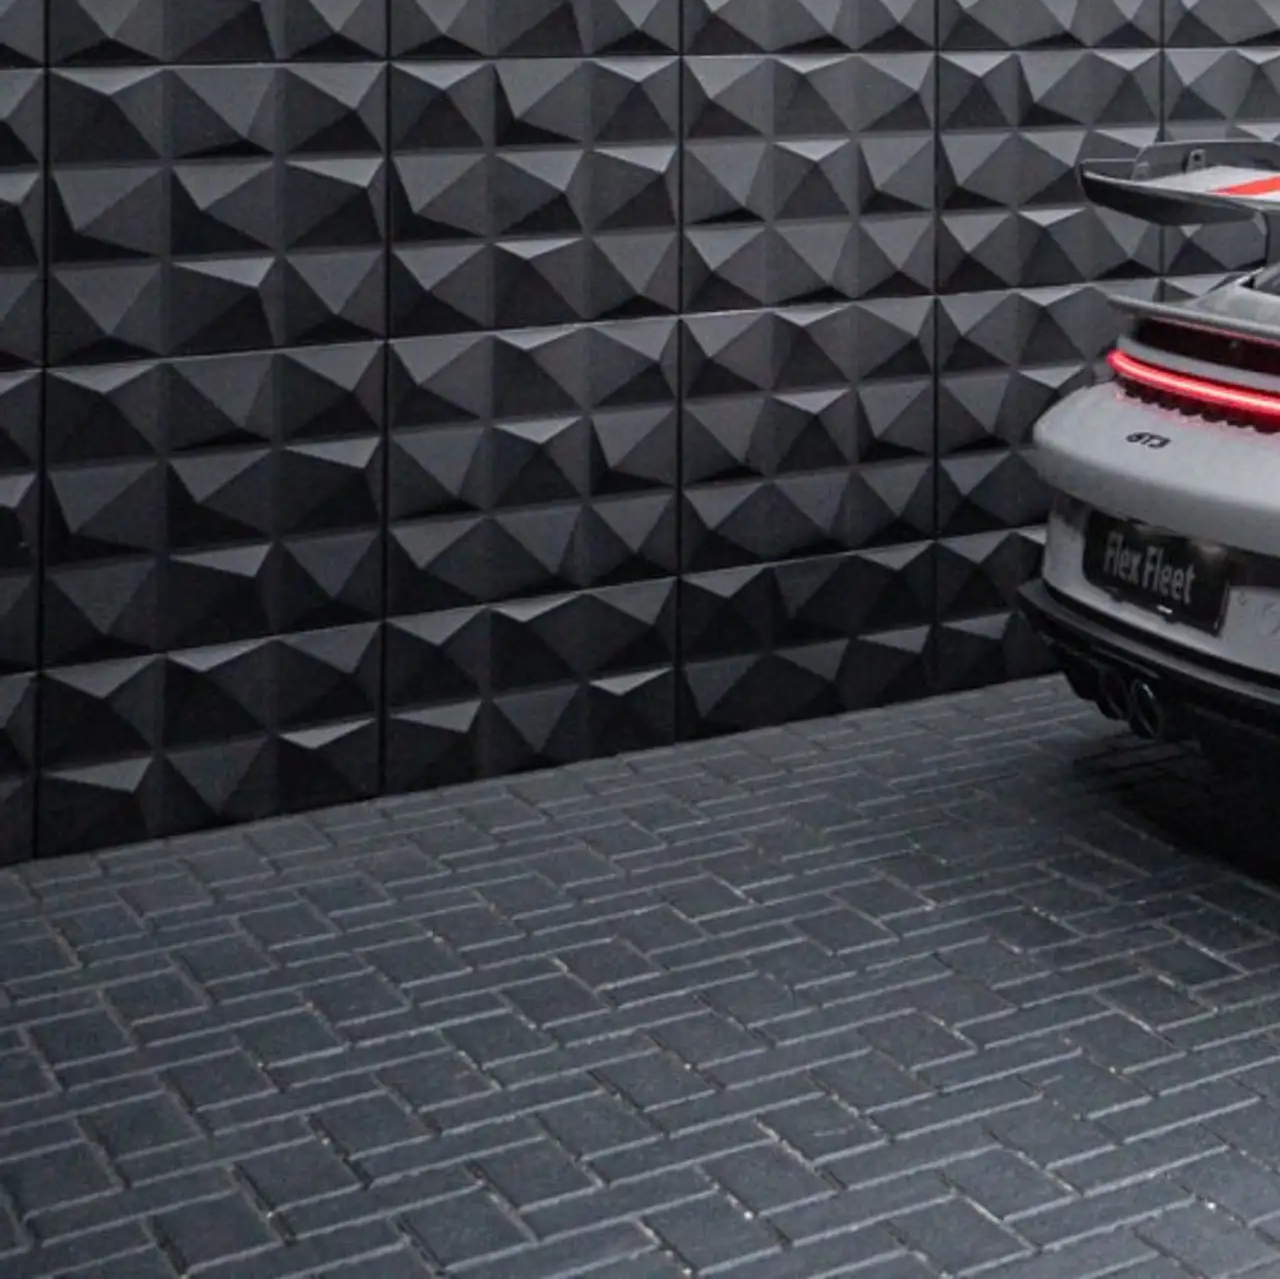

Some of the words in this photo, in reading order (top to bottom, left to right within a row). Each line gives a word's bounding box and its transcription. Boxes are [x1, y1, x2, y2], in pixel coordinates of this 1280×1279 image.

[1125, 431, 1171, 449] GT3
[1103, 530, 1142, 586] Flex
[1142, 544, 1197, 605] Fleet
